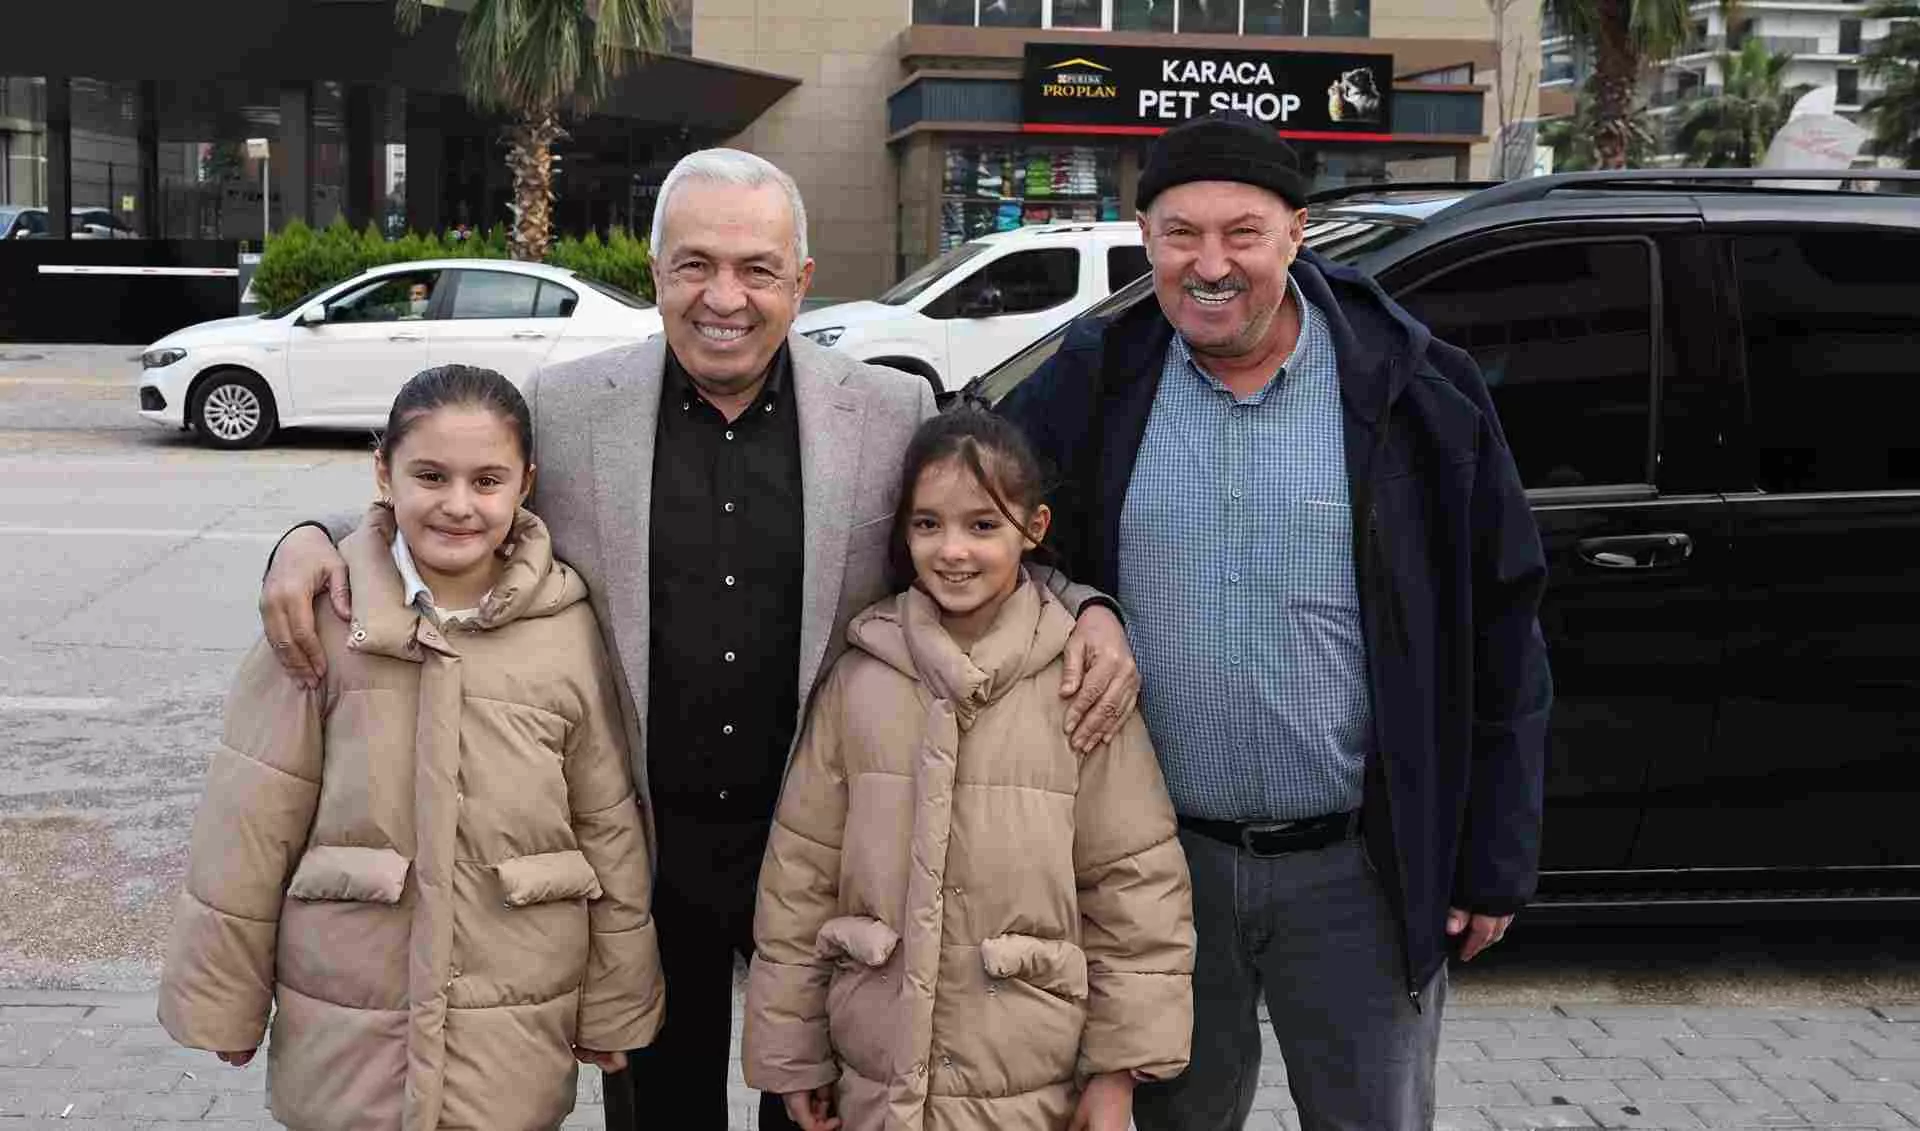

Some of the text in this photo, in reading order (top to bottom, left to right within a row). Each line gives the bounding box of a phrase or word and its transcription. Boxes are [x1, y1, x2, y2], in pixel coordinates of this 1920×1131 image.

[1163, 59, 1274, 85] KARACA
[1139, 89, 1300, 122] PET SHOP
